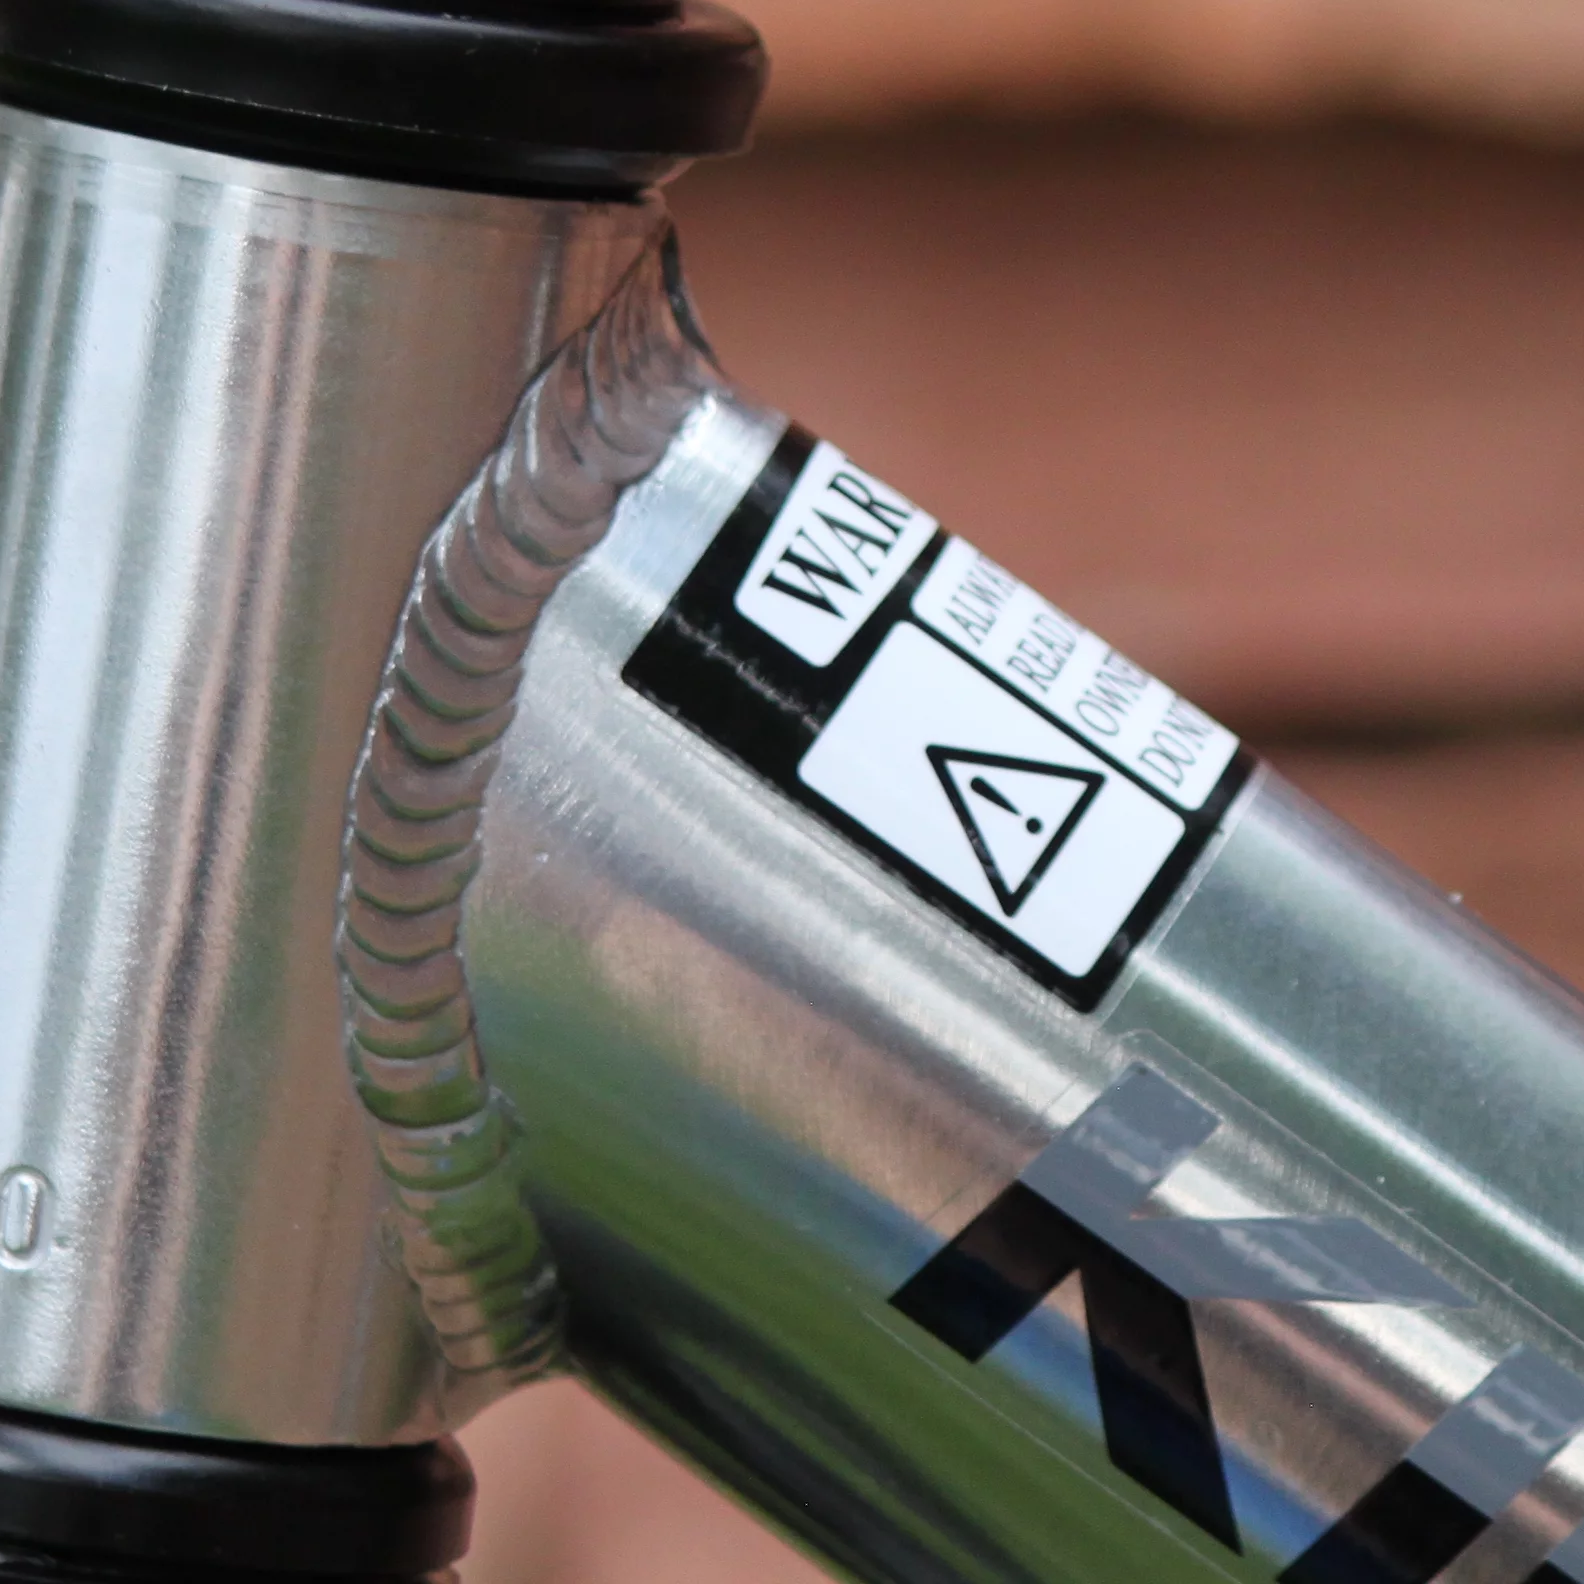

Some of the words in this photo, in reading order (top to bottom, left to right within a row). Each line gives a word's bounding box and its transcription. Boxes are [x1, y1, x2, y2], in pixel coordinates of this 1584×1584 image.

[761, 458, 914, 621] WAR
[943, 552, 1017, 647] ALWA
[1005, 612, 1078, 694] READ
